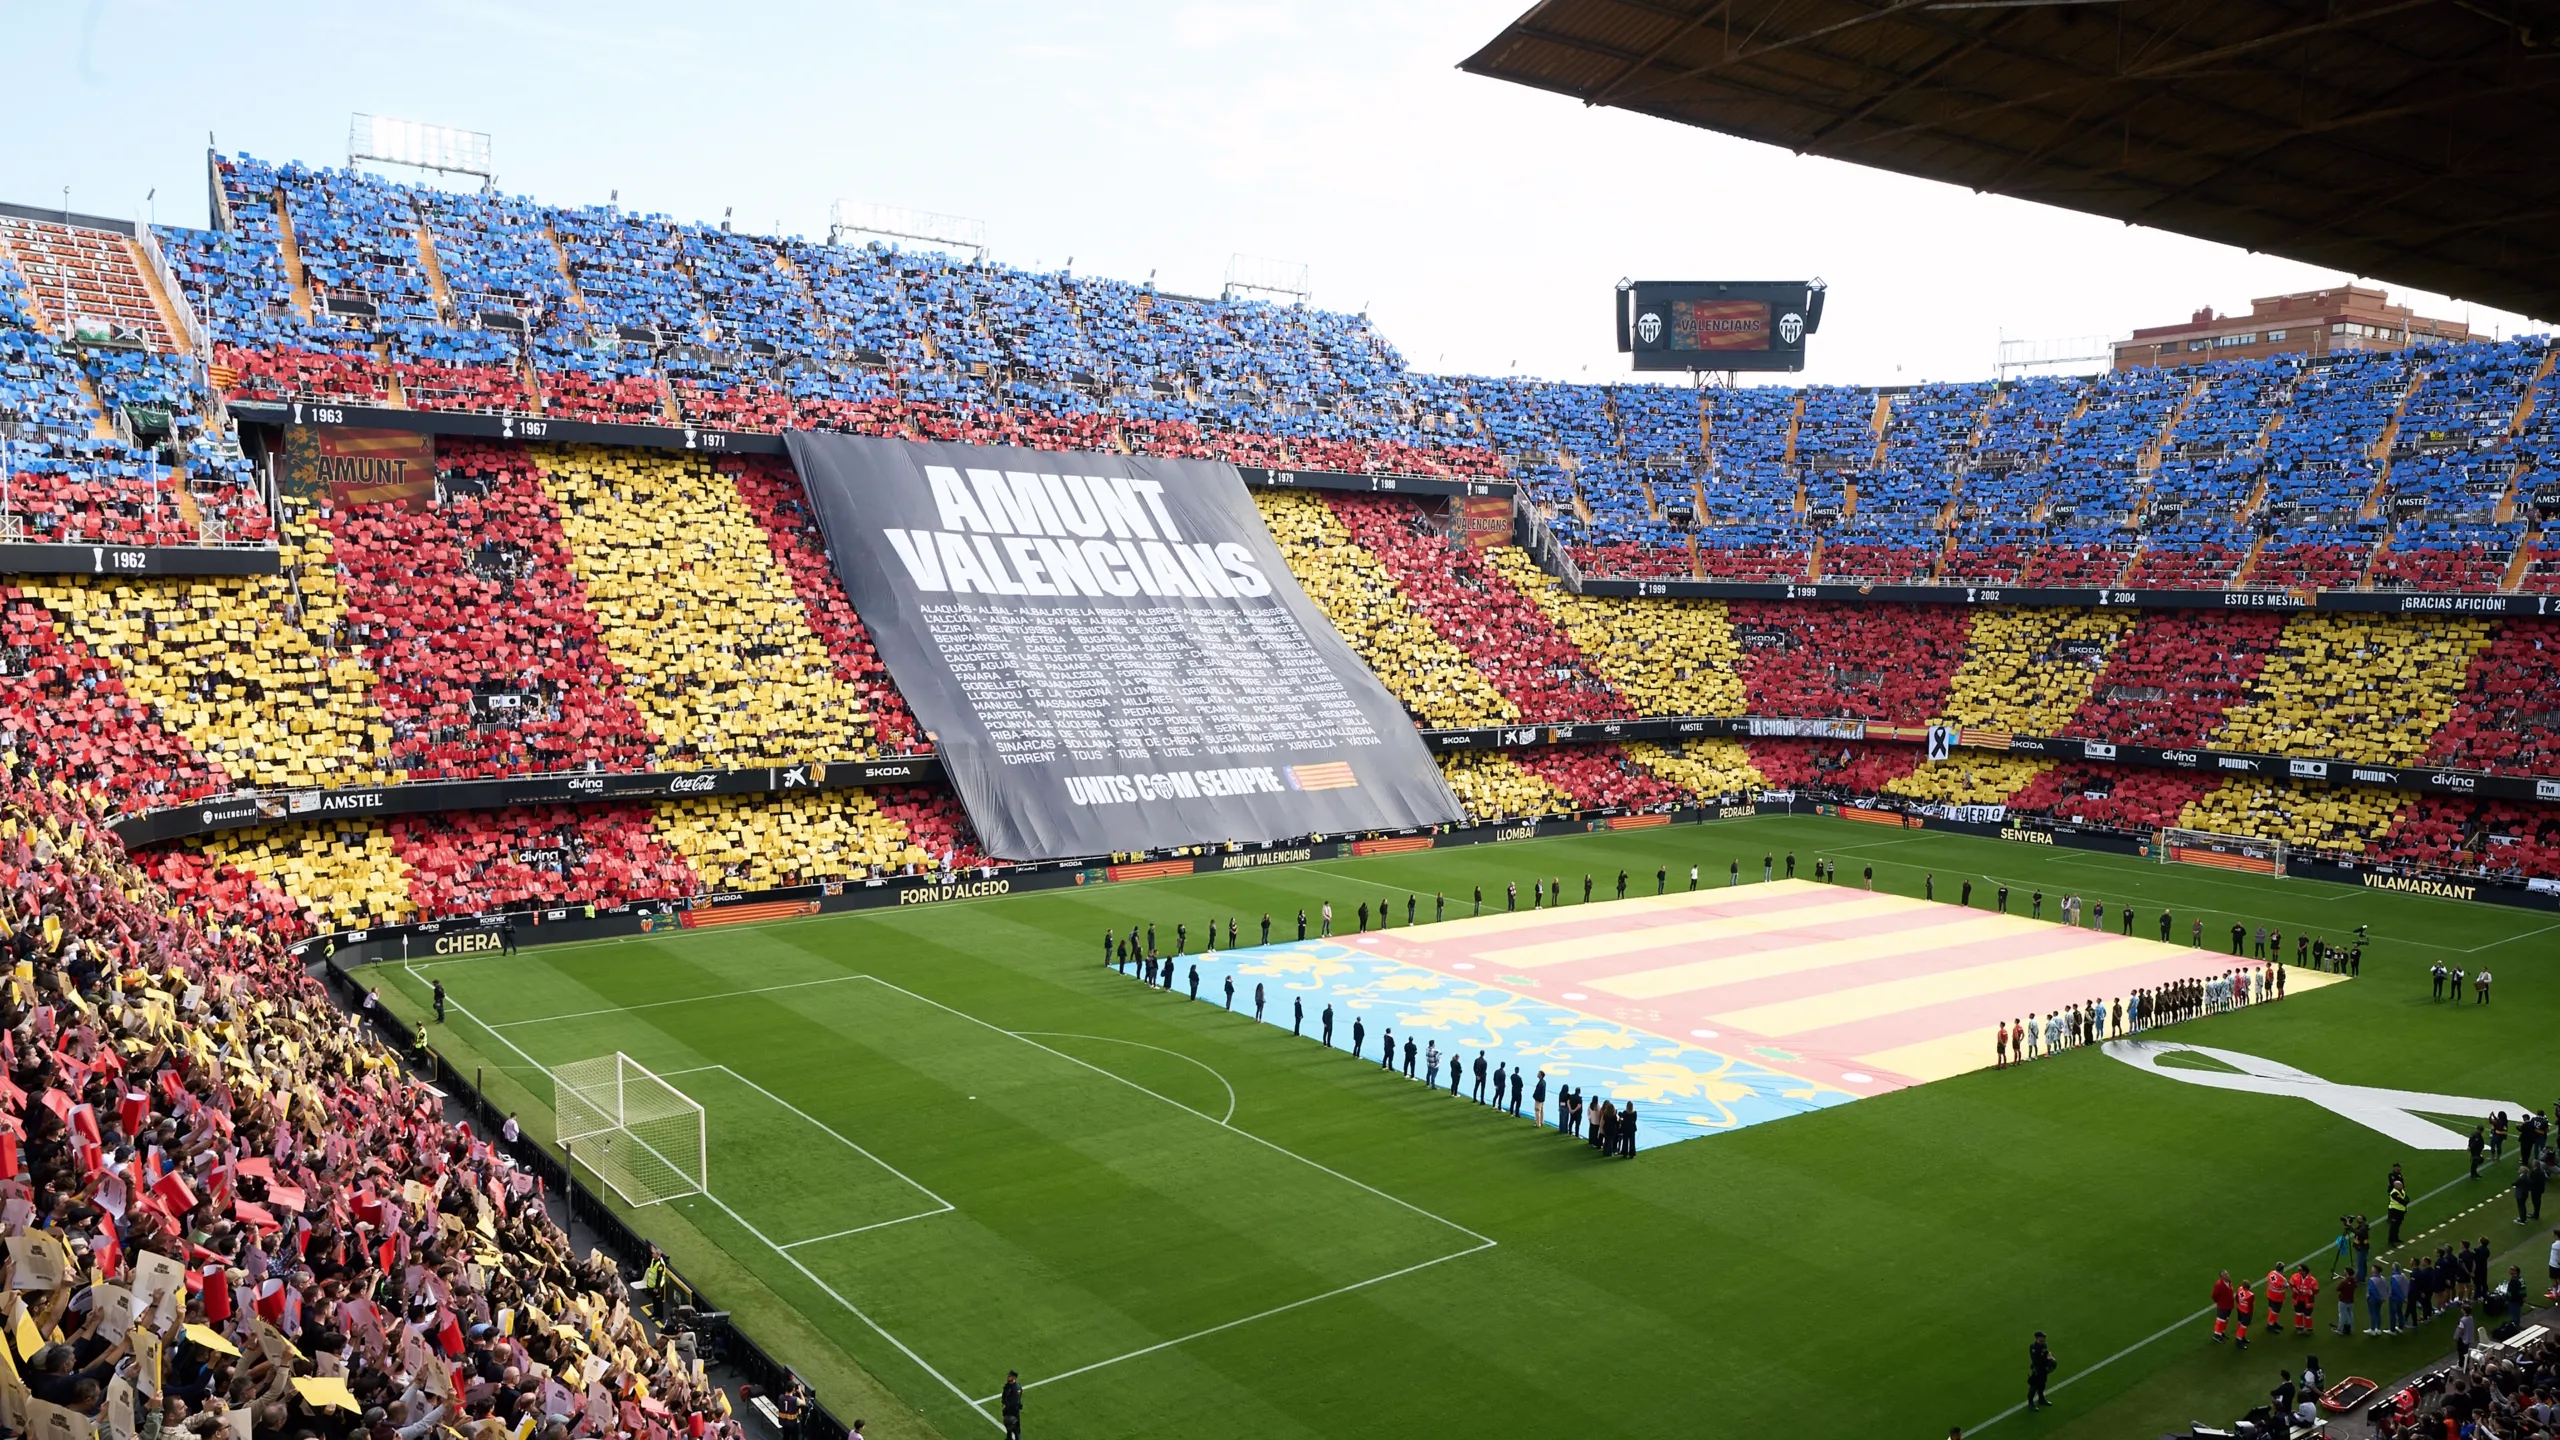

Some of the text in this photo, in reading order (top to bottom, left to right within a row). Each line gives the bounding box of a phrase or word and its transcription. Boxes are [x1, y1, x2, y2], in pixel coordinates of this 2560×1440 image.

[1681, 318, 1760, 332] VALENCIANS
[312, 408, 343, 424] 1963
[520, 421, 548, 436] 1967
[702, 434, 726, 448] 1971
[316, 455, 408, 485] AMUNT
[1278, 473, 1294, 483] 1979
[1381, 479, 1396, 489] 1980
[1475, 485, 1488, 495] 1980
[924, 465, 1183, 543] AMUNT
[1456, 516, 1508, 533] VALENCIANS
[112, 552, 146, 570] 1962
[883, 528, 1273, 598] VALENCIANS
[1649, 584, 1666, 594] 1999
[1798, 588, 1817, 597] 1999
[1981, 591, 2000, 601] 2002
[2115, 593, 2136, 603] 2004
[2225, 594, 2250, 605] ESTO
[2252, 595, 2264, 605] ES
[920, 603, 1237, 616] ALAQUÀS ALBAL ALBALAT RIBERA ALBERIC ALBORACHE
[2401, 597, 2506, 611] ¡GRACIAS AFICIÓN!
[924, 613, 1294, 626] L'ALCÚDIA ALDAIA ALFAFAR ALFARB ALMUSSAFES
[930, 624, 1122, 635] ALZIRA BENETÚSSER BENICULL
[934, 634, 1129, 644] BENIPARRELL BÉTERA BUGARRA
[939, 643, 1194, 653] CARCAIXENT CARLET CASTELLAR-OLIVERAL
[944, 652, 1184, 662] CAUDETE LAS FUENTES CHERA CHESTE
[950, 661, 1178, 672] DOS AGUAS PALMAR PERELLONET
[955, 672, 1001, 681] FAVARA
[1014, 670, 1046, 679] FORN
[1051, 671, 1103, 680] D'ALCEDO
[1186, 669, 1267, 678] FUENTERROBLES
[1277, 666, 1331, 676] GESTALGAR
[961, 679, 1111, 690] GODELLETA GUADASSUAR
[966, 686, 1293, 700] LLOCNOU DE CORONA LLOMBAI LORIGUILLA MACASTRE
[972, 692, 1350, 711] MANUEL MASSANASSA MILLARES MISLATA MONTSERRAT
[978, 704, 1305, 720] PAIPORTA PATERNA PEDRALBA PICANYA PICASSENT
[1036, 716, 1202, 729] DE XÚQUER QUART POBLET
[1680, 723, 1703, 731] AMSTEL
[1750, 721, 1761, 736] LA
[1761, 720, 1795, 736] CURVA
[990, 719, 1335, 740] RIBA-ROJA RIOLA SENYERA AGUAS
[996, 726, 1376, 752] SINARCAS SOLLANA DE CHERA SUECA TAVERNES DE VALLDIGNA
[1443, 736, 1470, 744] SKODA
[1000, 739, 1337, 765] TORRENT TOUS TURÍS UTIEL VILAMARXANT XIRIVELLA
[2162, 750, 2196, 762] divina
[2219, 758, 2249, 769] PUMA
[866, 766, 910, 777] SKODA
[2352, 770, 2386, 782] PUMA
[568, 778, 603, 789] divina
[671, 775, 718, 792] Coca-Cola
[1064, 774, 1138, 806] UNITS
[1194, 767, 1285, 796] SEMPRE
[2432, 774, 2474, 787] divina
[2540, 786, 2555, 794] TM
[323, 794, 383, 810] AMSTEL
[1720, 804, 1755, 818] PEDRALBA
[1497, 827, 1534, 841] LLOMBAI
[2001, 828, 2053, 845] SENYERA
[519, 850, 559, 863] divina
[1223, 849, 1311, 868] AMUNT VALENCIANS
[900, 880, 1009, 905] FORN D'ALCEDO
[2363, 873, 2476, 900] VILAMARXANT
[713, 894, 743, 902] SKODA
[419, 924, 440, 932] divina
[435, 933, 502, 954] CHERA
